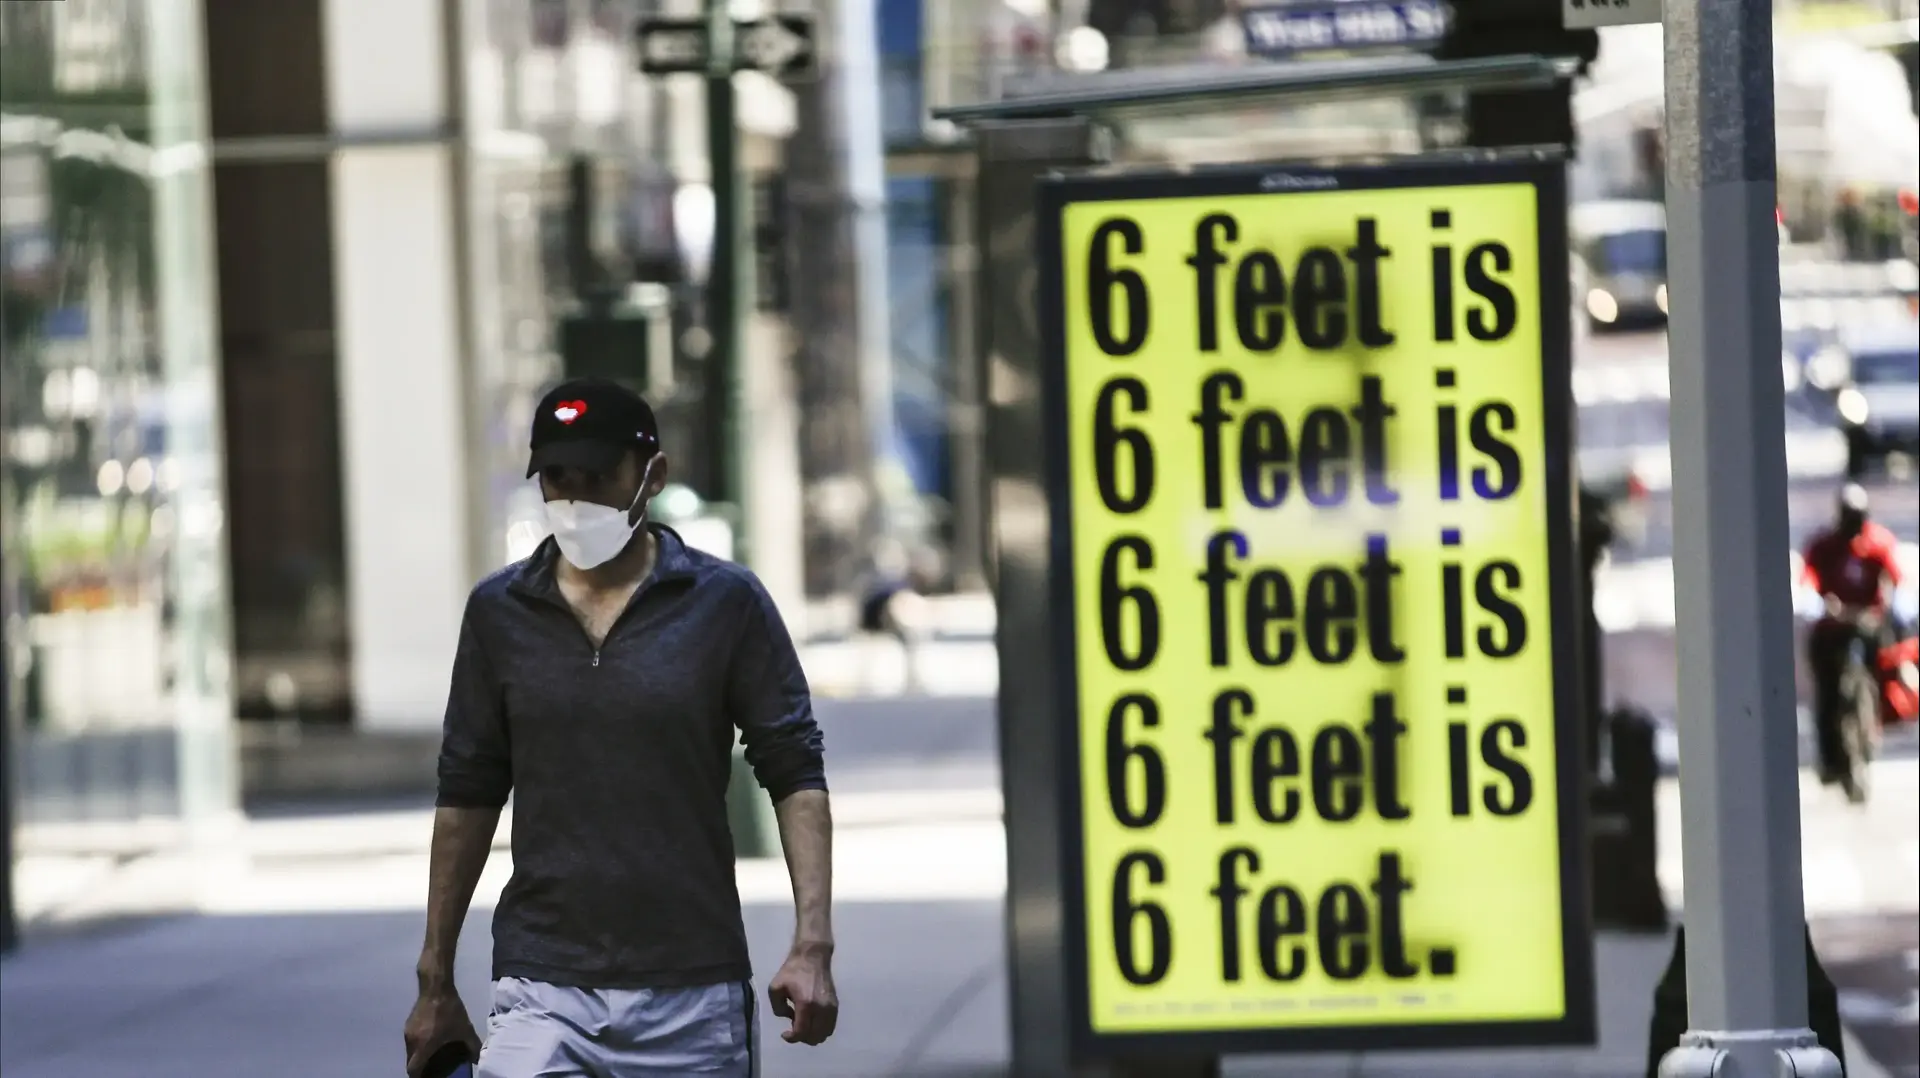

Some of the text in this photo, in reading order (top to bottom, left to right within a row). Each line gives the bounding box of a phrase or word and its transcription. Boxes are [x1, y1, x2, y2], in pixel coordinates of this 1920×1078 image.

[1087, 210, 1517, 356] 6 feet is
[1093, 370, 1522, 514] 6 feet is
[1099, 529, 1527, 671] 6 feet is
[1106, 687, 1533, 829] 6 feet is
[1112, 847, 1457, 986] 6 feet.
